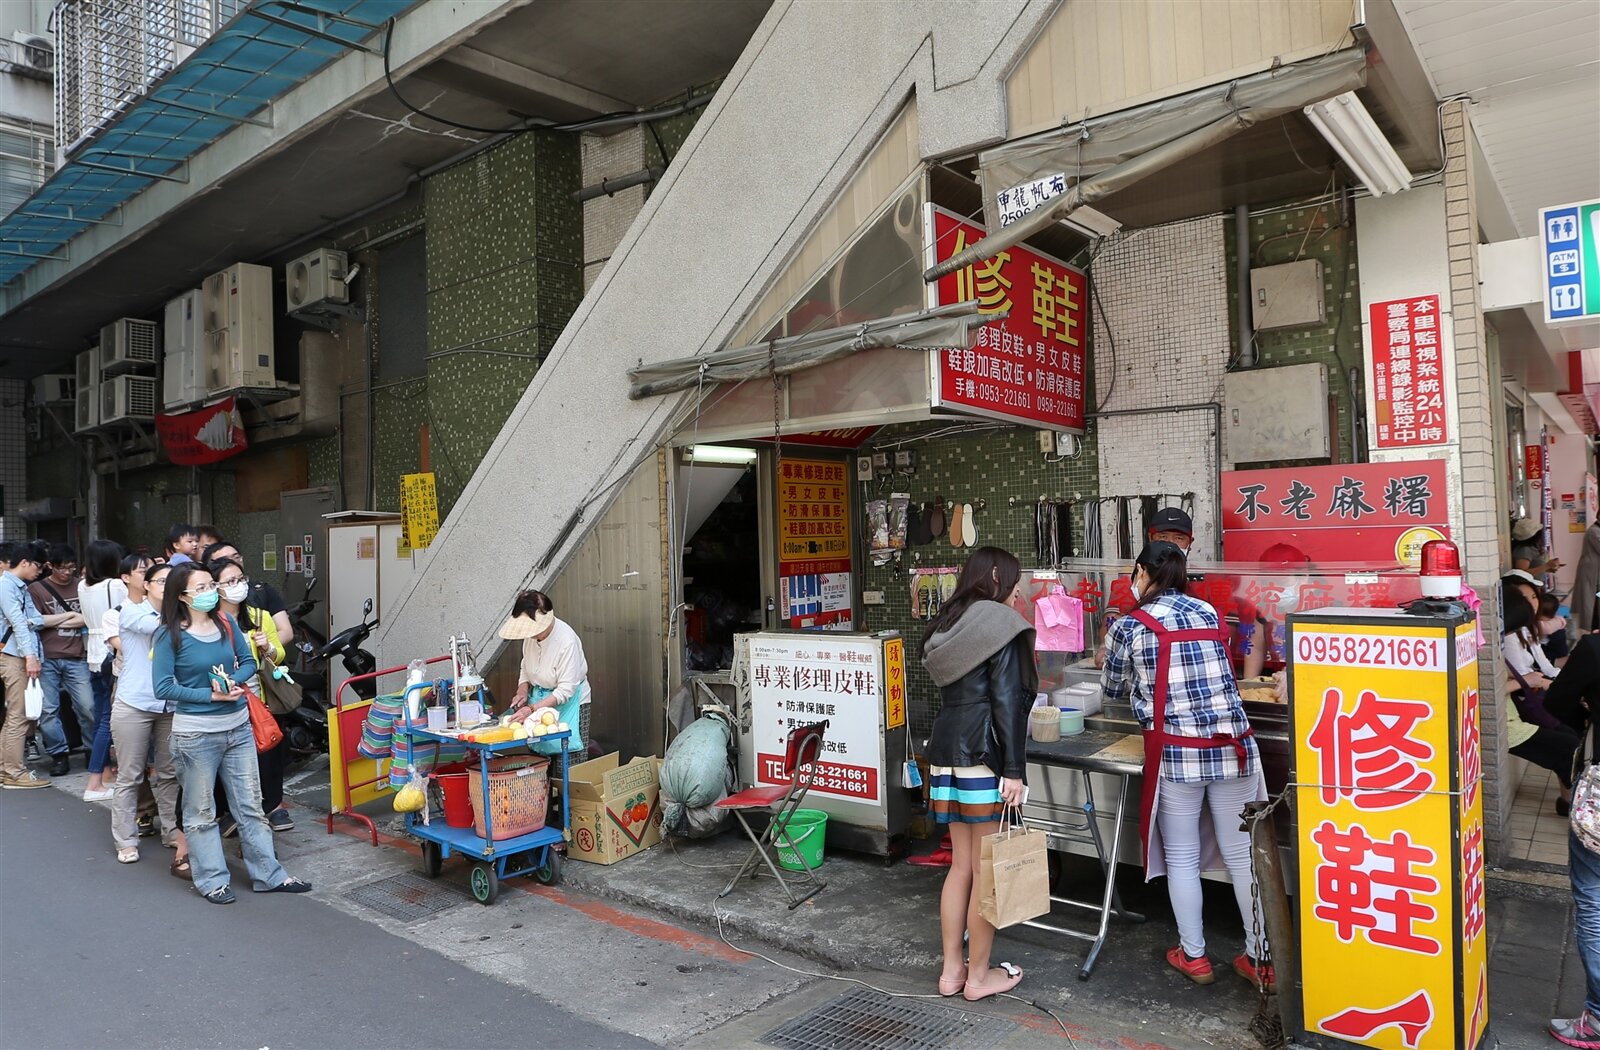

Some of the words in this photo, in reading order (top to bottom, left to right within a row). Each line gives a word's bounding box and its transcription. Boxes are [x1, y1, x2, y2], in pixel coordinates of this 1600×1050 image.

[1552, 252, 1576, 262] ATM
[951, 229, 1080, 346] 修鞋
[1412, 299, 1443, 441] 本里監視系統24小時
[783, 464, 844, 480] 專業修理皮鞋
[788, 485, 841, 500] 男女皮鞋
[1235, 475, 1432, 522] 不老麻糬
[788, 503, 842, 518] 防滑保護底
[1299, 635, 1438, 667] 0958221661
[754, 664, 875, 696] 專業修理皮鞋
[889, 645, 901, 720] 請勿動手
[786, 700, 836, 716] 防滑保護底
[800, 763, 867, 781] 093-221661
[1307, 688, 1442, 956] 修鞋
[1459, 687, 1485, 952] 修鞋
